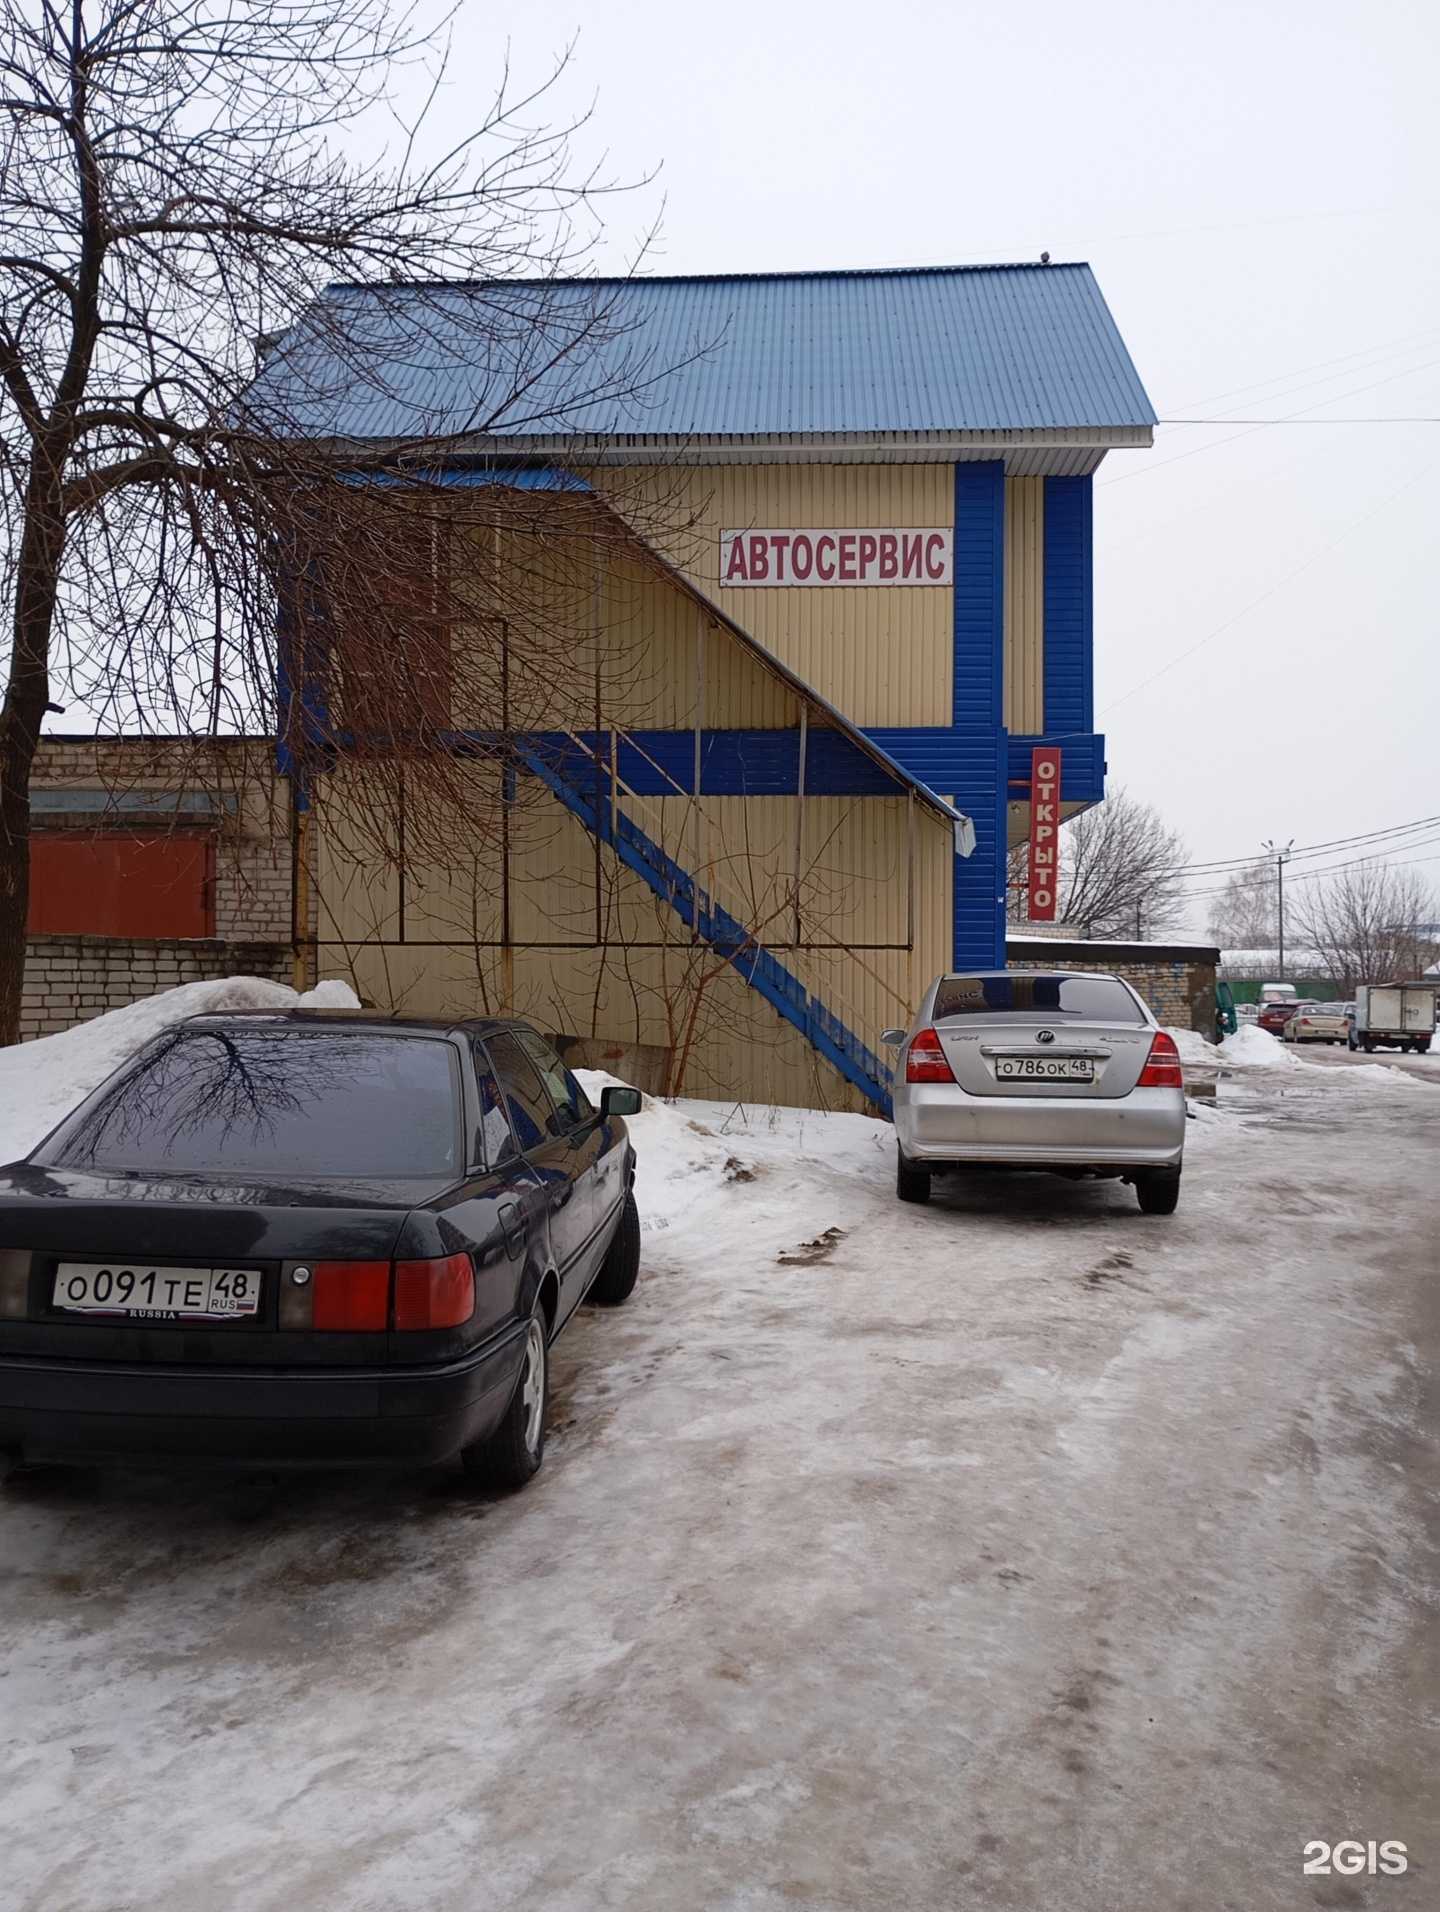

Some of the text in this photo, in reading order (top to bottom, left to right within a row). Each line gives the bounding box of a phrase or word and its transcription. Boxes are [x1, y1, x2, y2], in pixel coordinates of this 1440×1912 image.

[726, 534, 945, 581] АВТОСЕРВИС
[1034, 762, 1055, 908] ОТКРЫТО
[1071, 1060, 1087, 1072] 48
[214, 1272, 248, 1298] 48
[211, 1299, 236, 1310] RUS
[129, 1309, 176, 1320] RUSSIA
